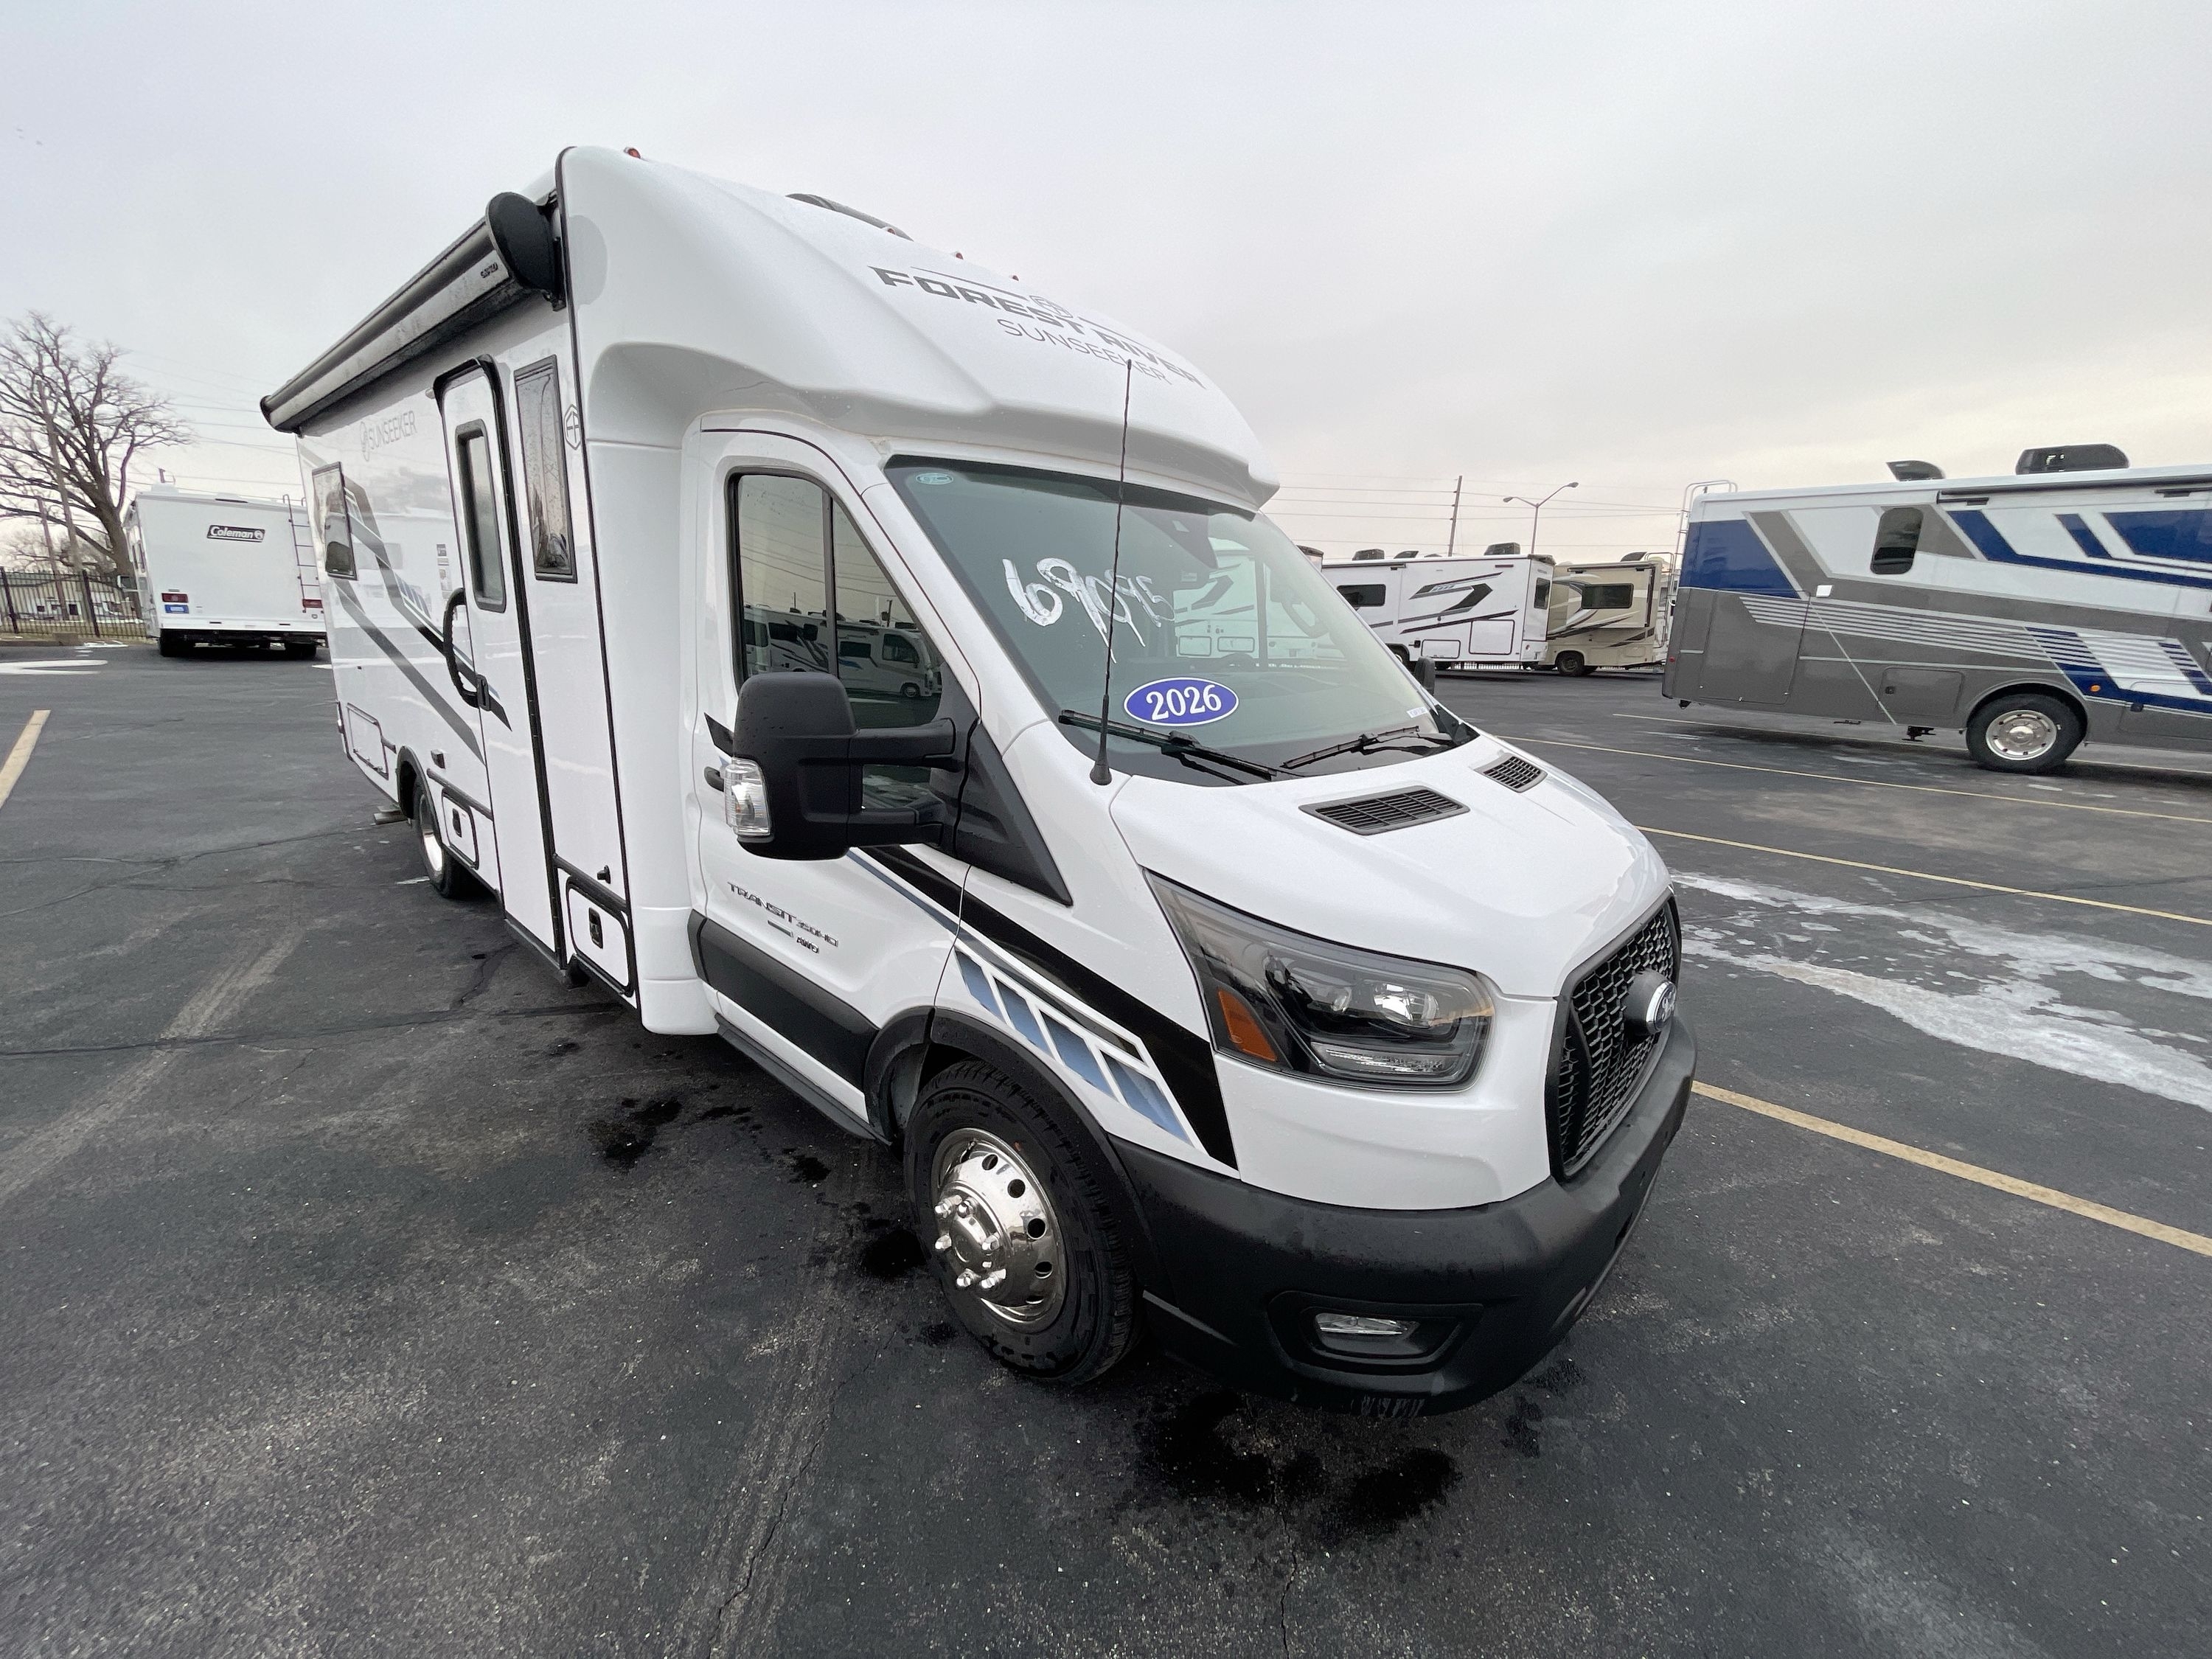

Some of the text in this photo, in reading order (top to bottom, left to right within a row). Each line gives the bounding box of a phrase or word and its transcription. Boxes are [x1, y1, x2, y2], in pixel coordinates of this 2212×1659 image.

[867, 266, 1207, 390] FOREST RIVER
[369, 410, 418, 451] SUNSEEKER
[210, 526, 254, 539] Coleman
[1145, 684, 1222, 721] 2026
[728, 881, 797, 923] TRANSIT
[796, 935, 820, 954] AWD
